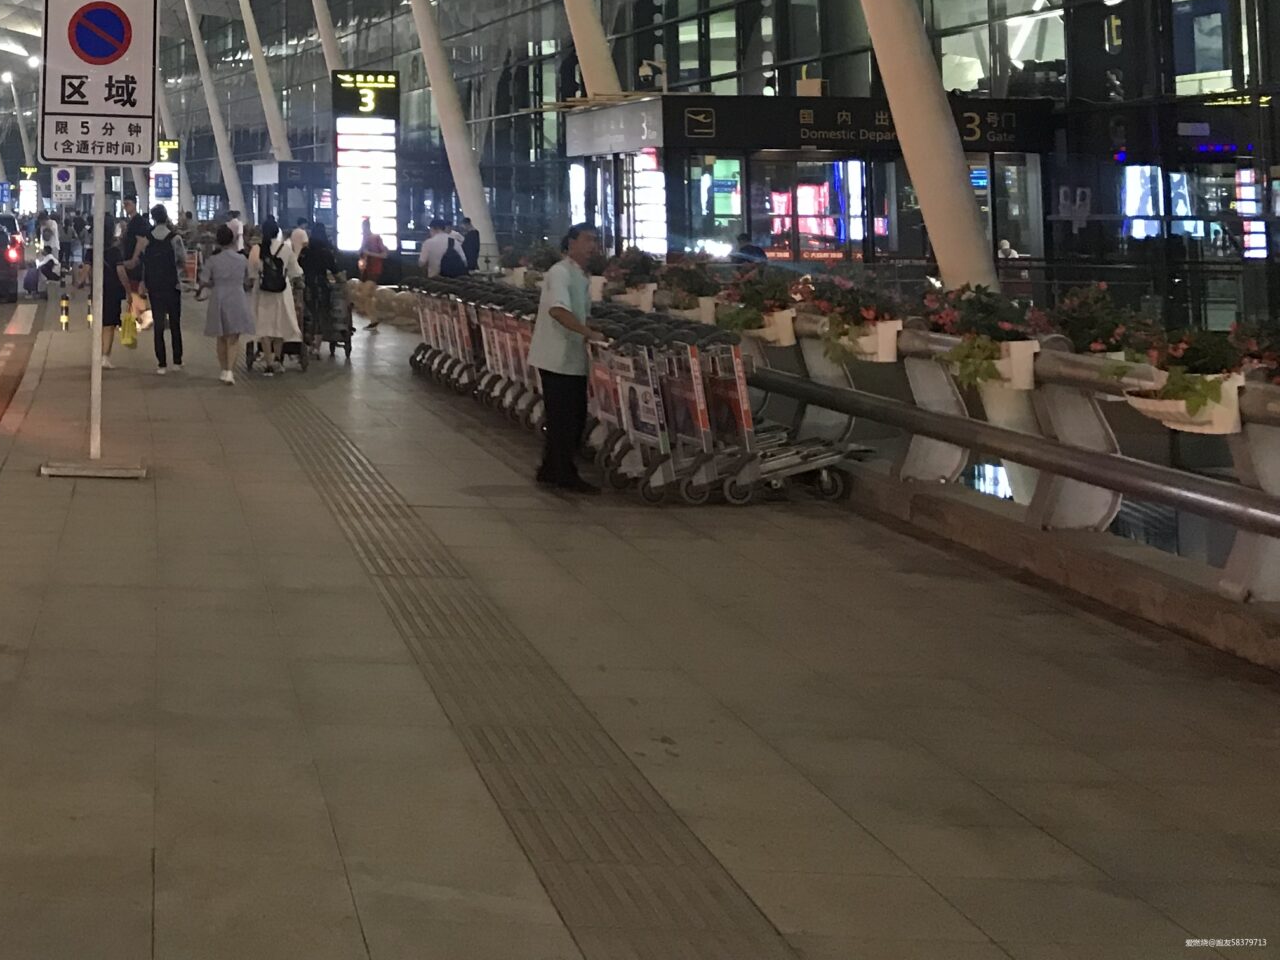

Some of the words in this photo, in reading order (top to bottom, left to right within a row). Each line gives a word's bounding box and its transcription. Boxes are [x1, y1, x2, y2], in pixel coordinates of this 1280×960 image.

[60, 74, 138, 108] 区域
[358, 88, 375, 112] 3
[799, 109, 890, 126] 国内出
[962, 112, 981, 142] 3
[985, 111, 1017, 128] 号门
[800, 128, 857, 140] Domestic
[859, 129, 896, 143] Depar
[986, 130, 1017, 142] Gate
[160, 148, 169, 161] 5
